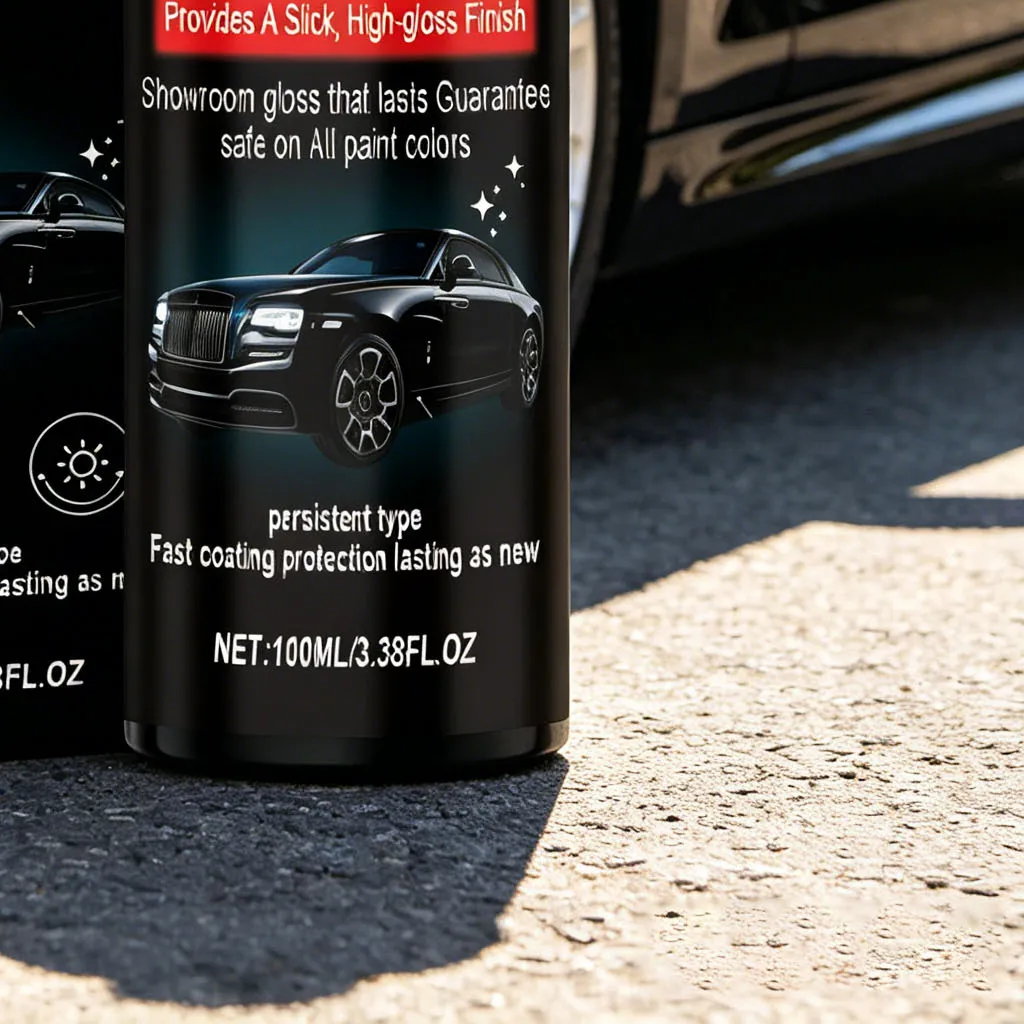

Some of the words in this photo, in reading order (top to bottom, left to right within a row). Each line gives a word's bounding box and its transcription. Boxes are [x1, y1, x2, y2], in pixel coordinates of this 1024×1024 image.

[164, 0, 256, 35] Provides
[259, 2, 279, 36] A
[283, 2, 340, 43] Slick,
[347, 2, 458, 43] High-gloss
[464, 0, 526, 34] Finish
[141, 76, 255, 113] Showroom
[263, 80, 321, 124] gloss
[326, 81, 371, 115] that
[378, 81, 428, 114] lasts
[435, 77, 551, 113] Guarantee
[220, 124, 266, 160] safe
[273, 134, 301, 160] on
[309, 127, 336, 160] All
[344, 126, 398, 169] paint
[405, 126, 471, 160] colors
[268, 501, 373, 539] persistent
[376, 505, 422, 540] type
[150, 532, 193, 567] Fast
[199, 541, 275, 579] coating
[282, 543, 387, 580] protection
[394, 540, 463, 578] lasting
[469, 544, 493, 569] as
[499, 539, 541, 567] new
[77, 573, 103, 593] as
